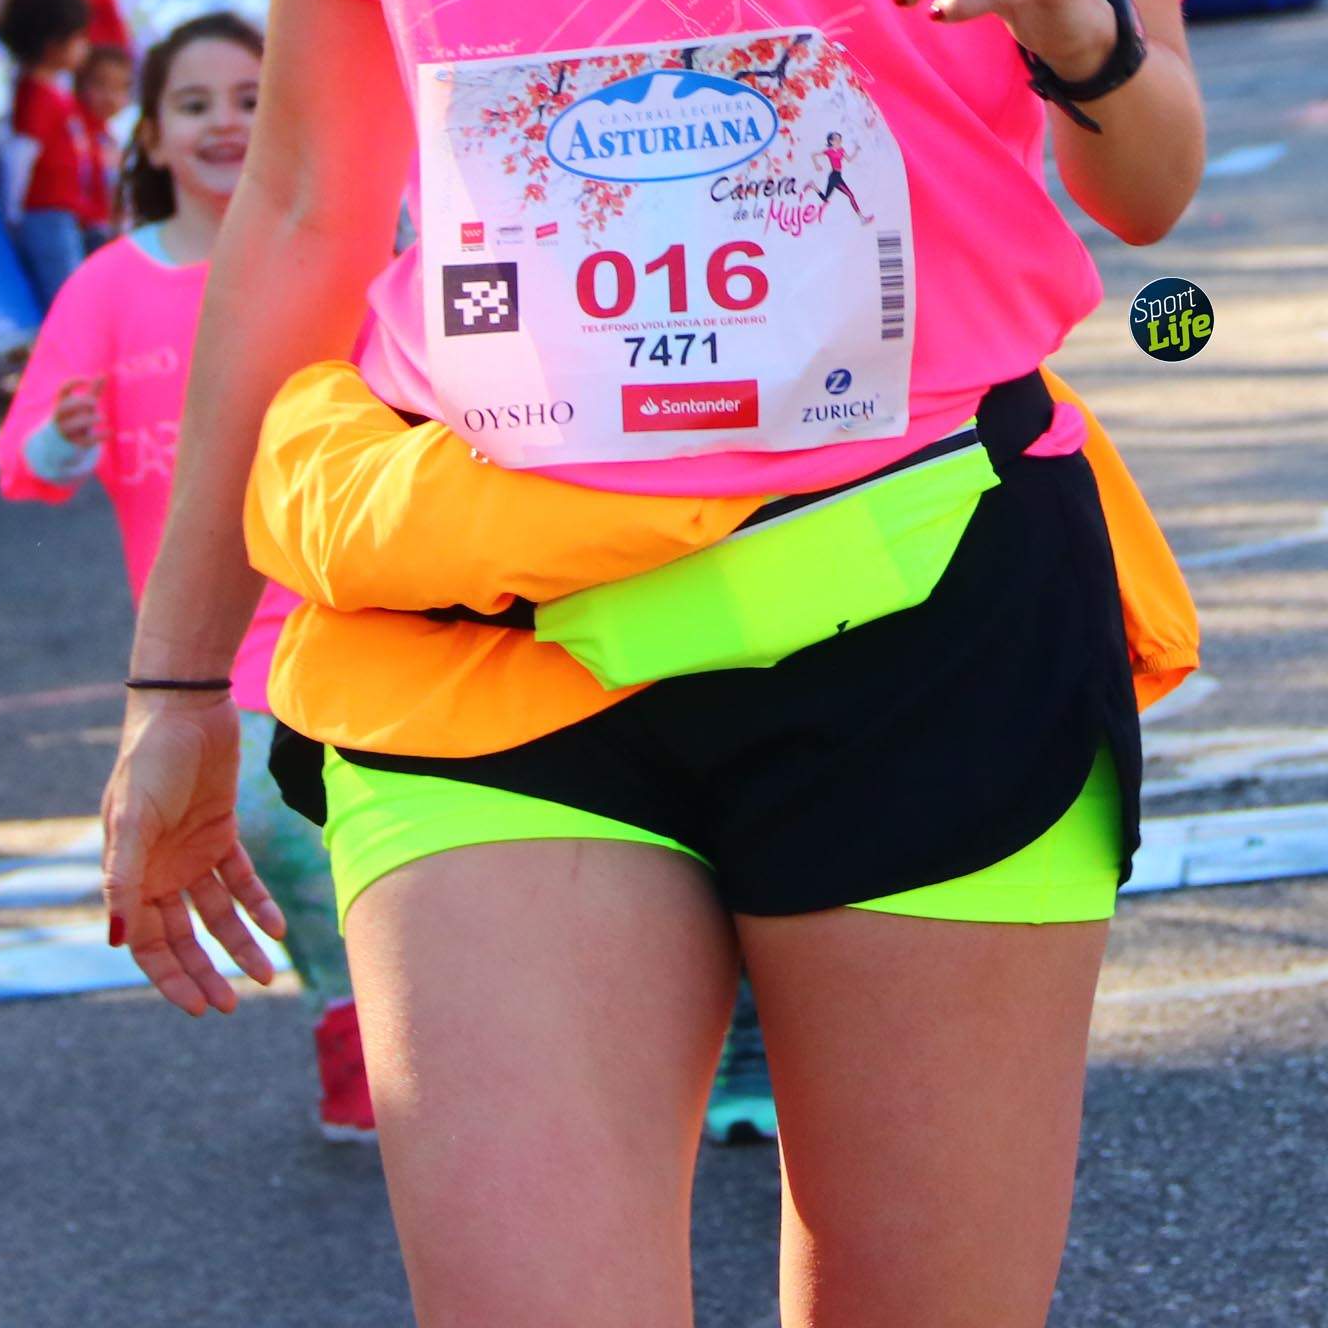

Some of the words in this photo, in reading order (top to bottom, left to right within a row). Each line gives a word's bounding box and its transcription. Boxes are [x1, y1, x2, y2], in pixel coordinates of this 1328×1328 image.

[600, 109, 671, 125] CENTRAL
[680, 100, 753, 118] LECHERA
[565, 116, 762, 162] ASTURIANA
[710, 176, 796, 202] Carrera
[733, 206, 748, 221] de
[753, 200, 764, 219] la
[764, 193, 829, 238] Mujer
[575, 240, 770, 320] 016
[642, 319, 701, 331] VIOLENCIA
[703, 318, 719, 327] DE
[624, 332, 718, 368] 7471
[463, 400, 575, 433] OYSHO
[661, 397, 742, 416] Santander
[802, 400, 874, 423] ZURICH
